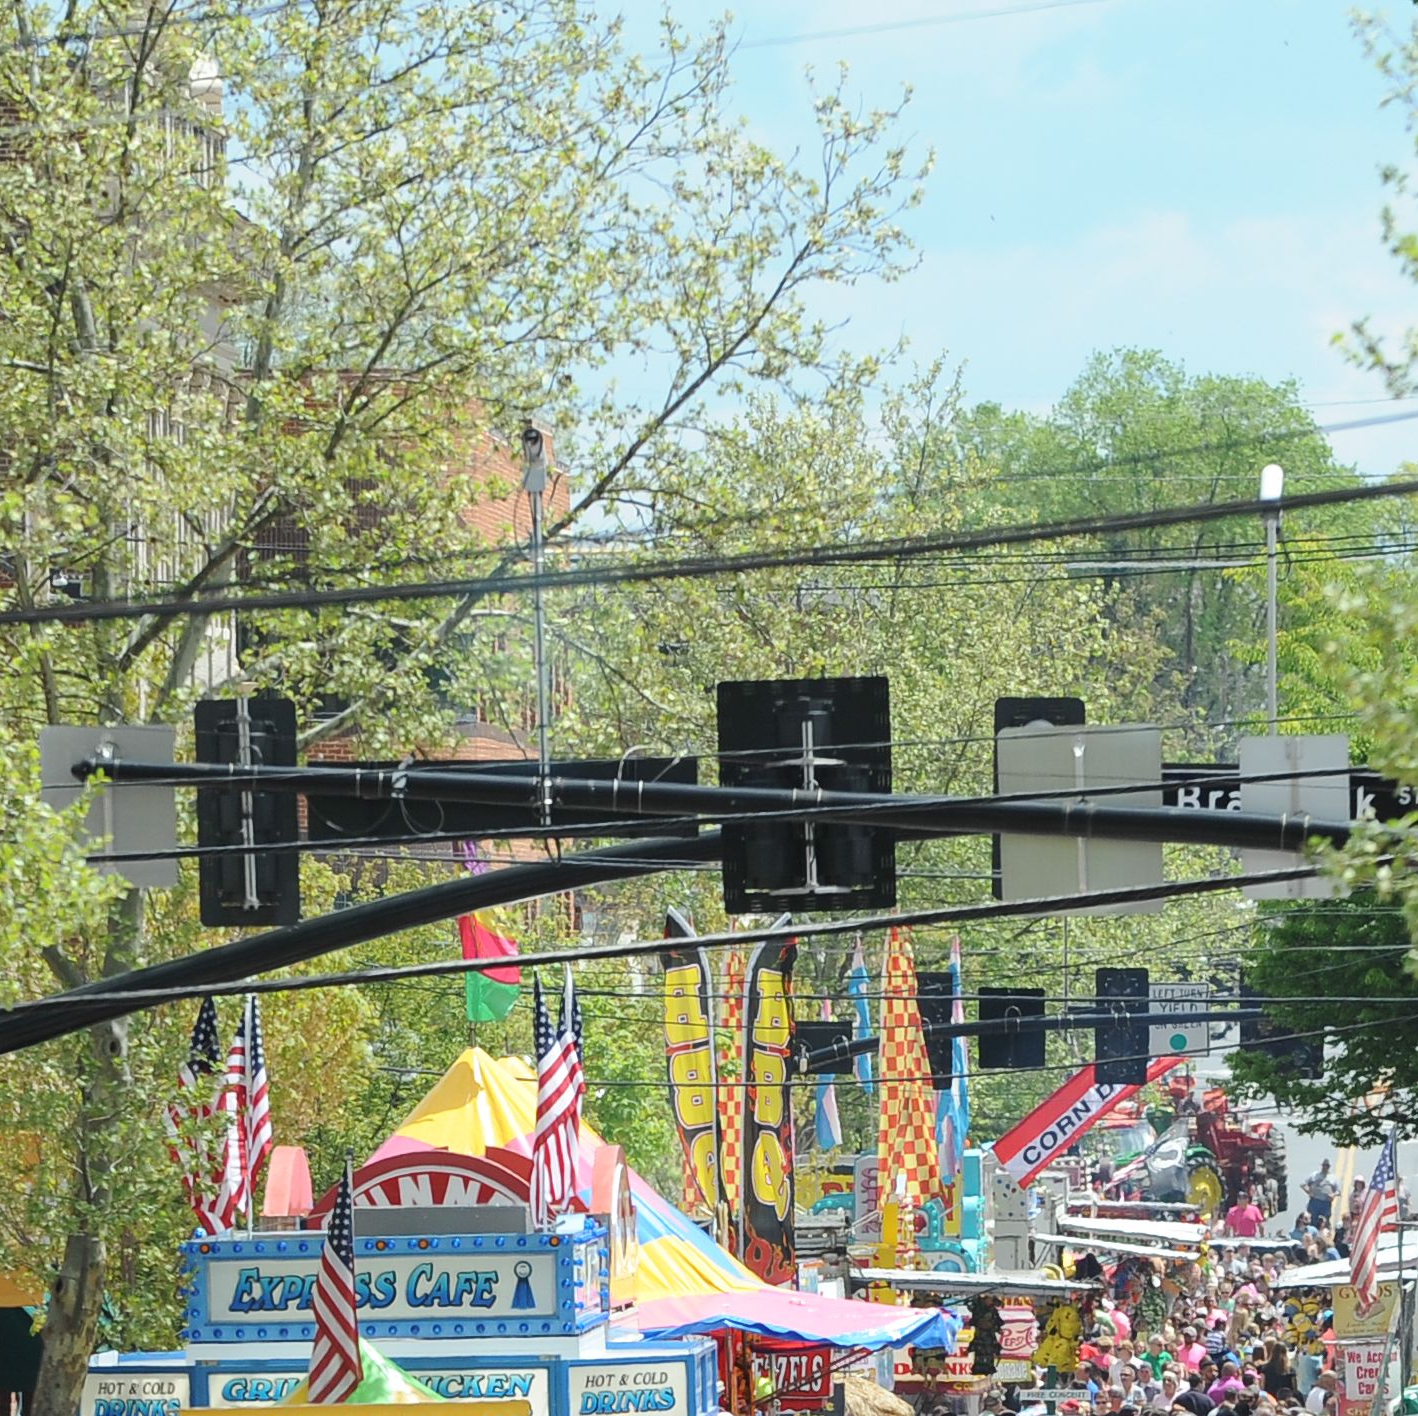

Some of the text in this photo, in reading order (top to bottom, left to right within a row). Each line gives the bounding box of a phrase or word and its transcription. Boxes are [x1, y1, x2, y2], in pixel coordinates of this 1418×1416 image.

[1022, 1100, 1092, 1165] CORN
[229, 1263, 500, 1313] EXPSS CAFE
[98, 1382, 176, 1395] HOT & COLD
[584, 1372, 669, 1388] HOT & COLD
[580, 1388, 676, 1416] DRINKS
